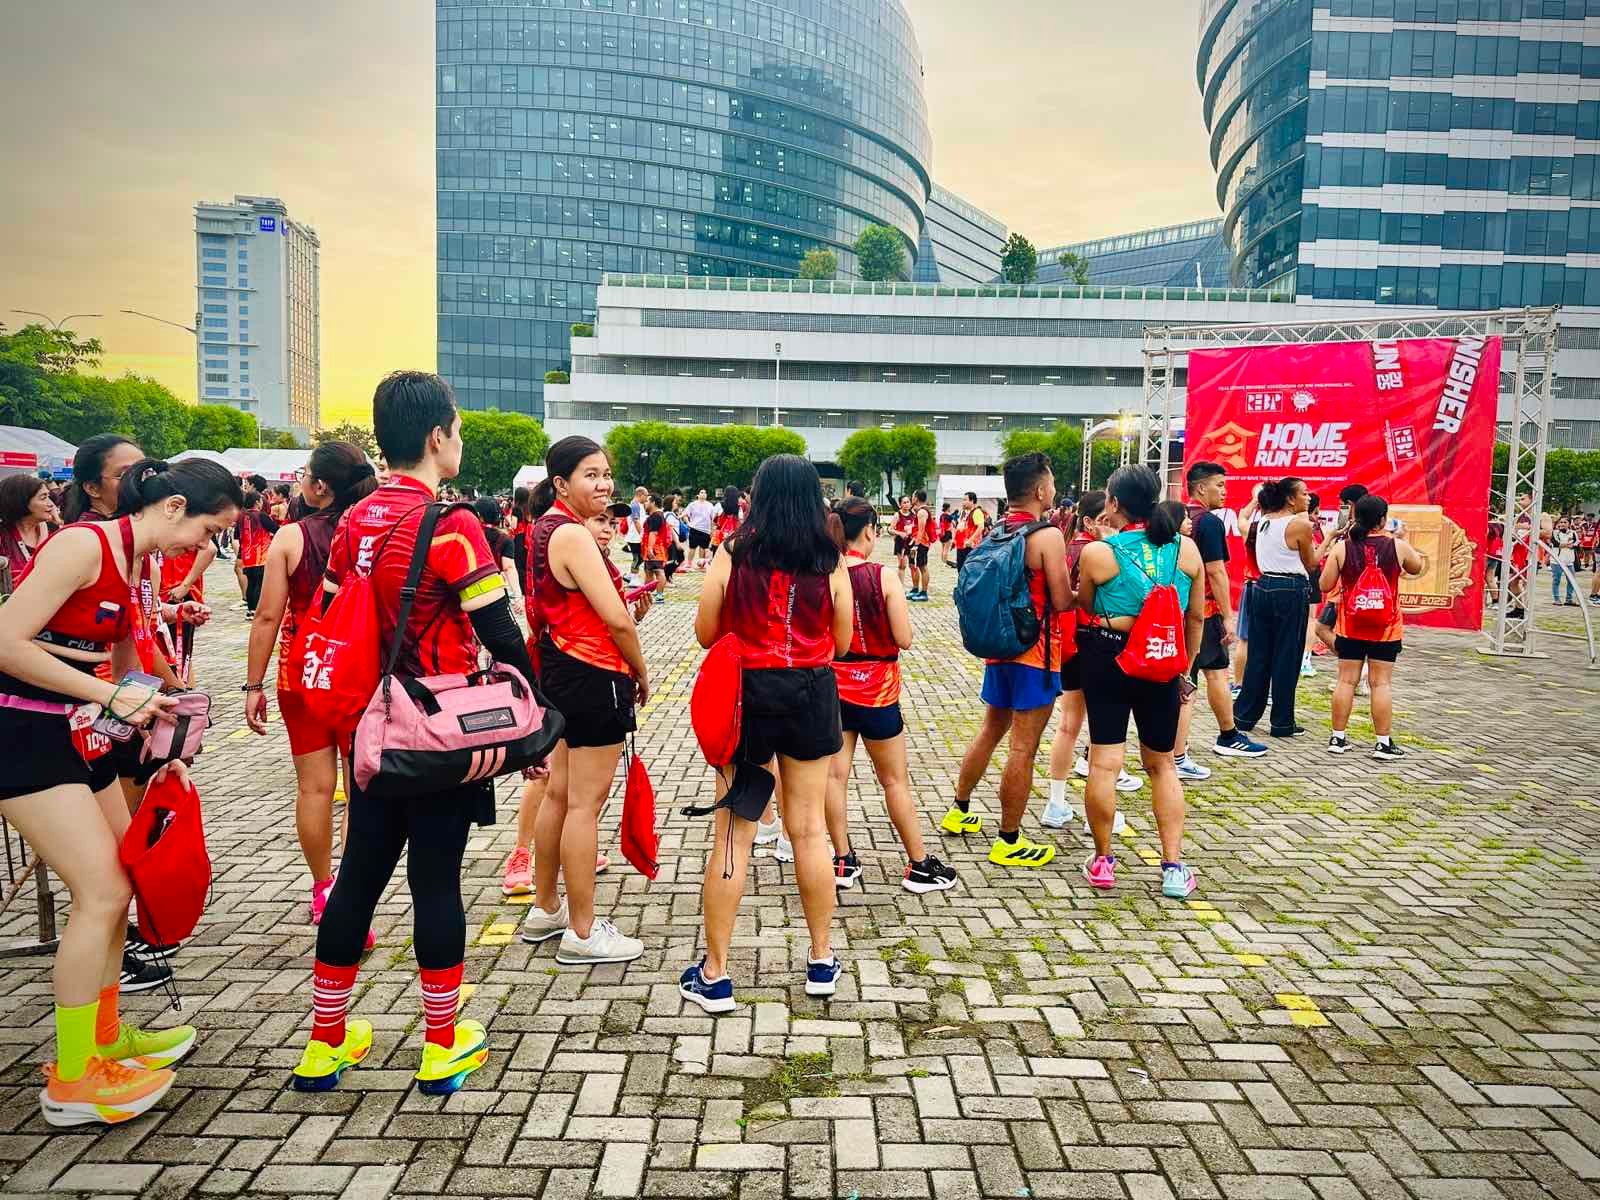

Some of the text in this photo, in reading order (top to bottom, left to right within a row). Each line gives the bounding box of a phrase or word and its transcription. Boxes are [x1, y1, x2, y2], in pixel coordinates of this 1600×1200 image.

[1258, 422, 1352, 450] HOME
[1254, 450, 1349, 467] RUN 2025
[1421, 595, 1448, 606] 2025
[68, 640, 95, 651] FILA
